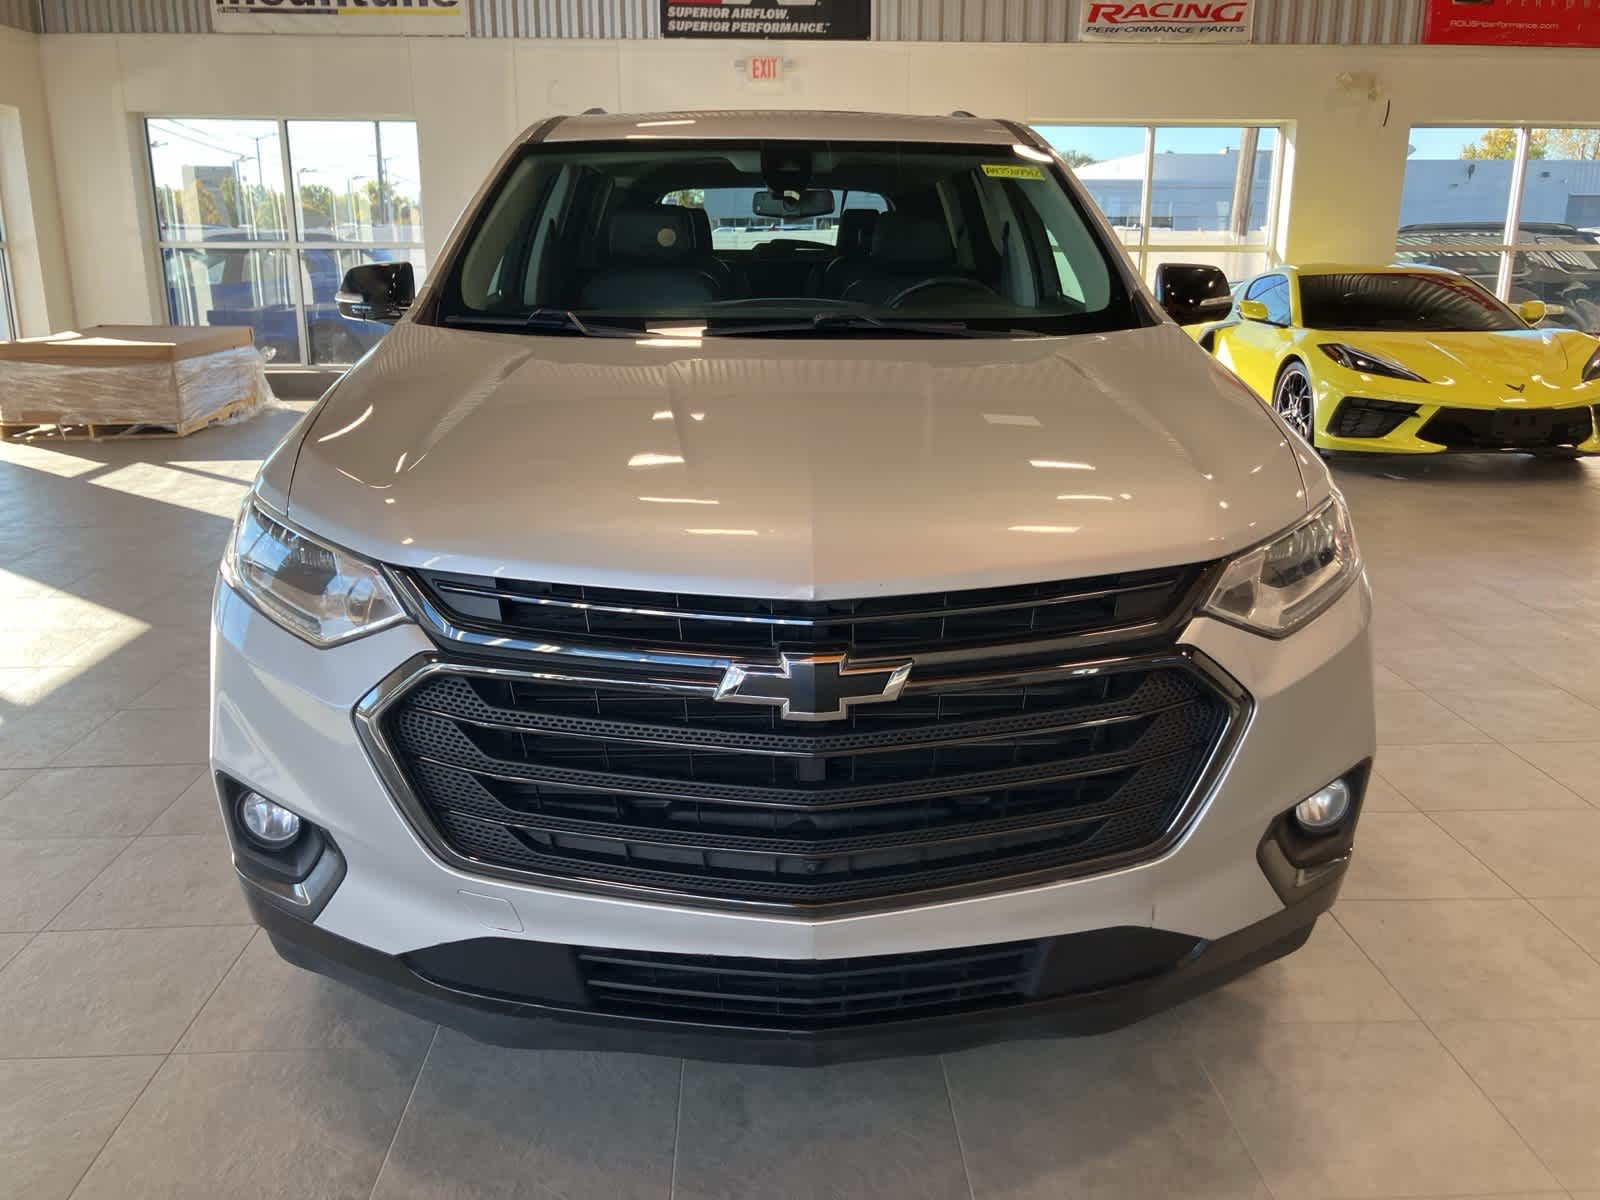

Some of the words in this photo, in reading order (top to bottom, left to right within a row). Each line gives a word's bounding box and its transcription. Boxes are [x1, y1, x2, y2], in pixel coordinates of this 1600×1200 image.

[668, 7, 730, 19] SUPERIOR
[731, 8, 789, 20] AIRFLOW.
[1088, 2, 1248, 23] RACING
[668, 21, 728, 32] SUPERIOR
[752, 58, 777, 80] EXIT
